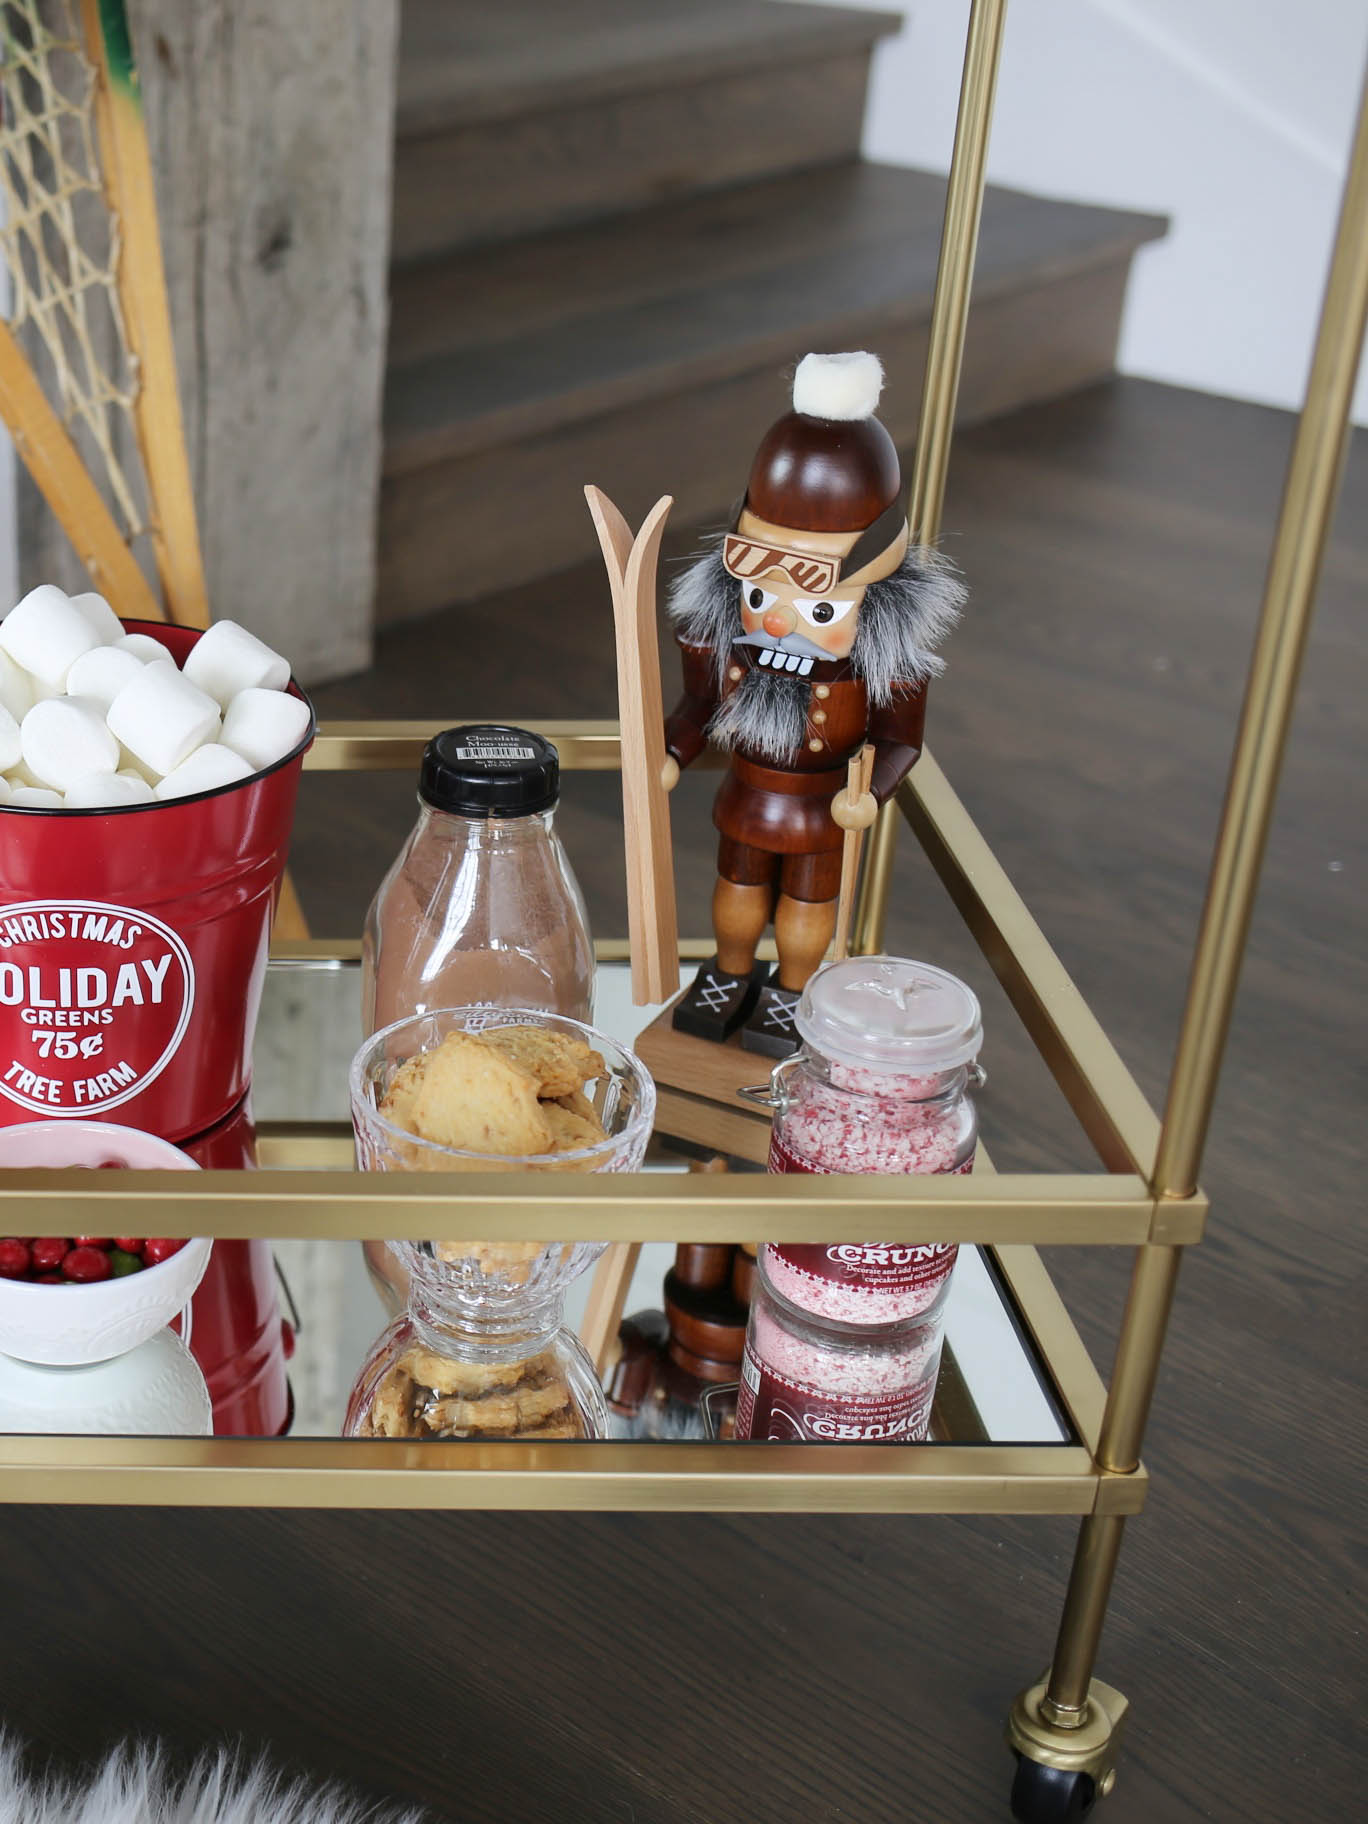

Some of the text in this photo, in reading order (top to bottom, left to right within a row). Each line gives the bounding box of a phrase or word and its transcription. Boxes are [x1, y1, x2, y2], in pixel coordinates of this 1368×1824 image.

[20, 1007, 114, 1026] GREENS
[31, 1029, 104, 1059] 75¢
[2, 1060, 138, 1103] TREE FARM
[846, 1264, 881, 1276] Decorate
[898, 1266, 912, 1274] add
[864, 1276, 899, 1286] cupcakes
[899, 1274, 913, 1282] and
[914, 1270, 932, 1280] other
